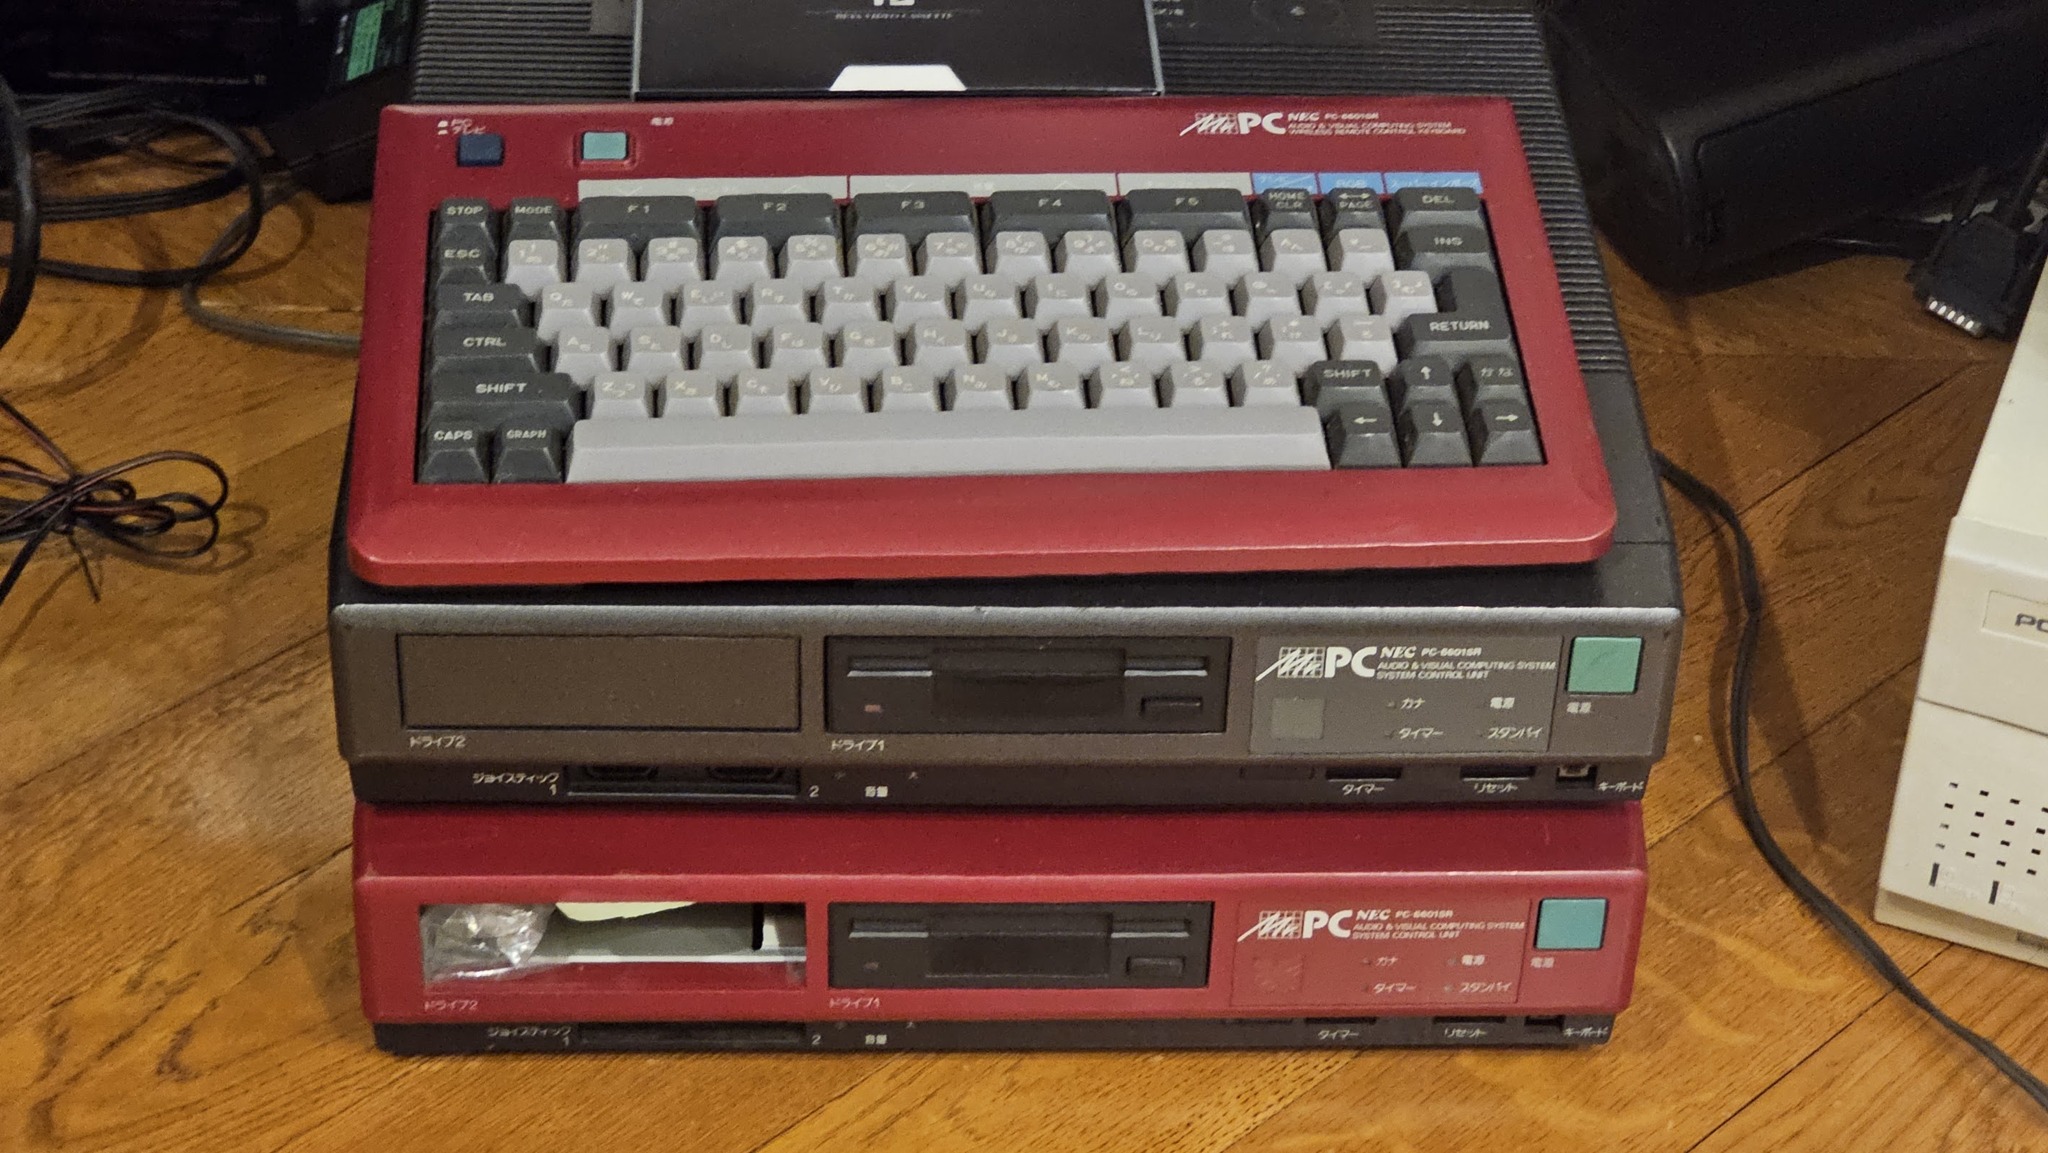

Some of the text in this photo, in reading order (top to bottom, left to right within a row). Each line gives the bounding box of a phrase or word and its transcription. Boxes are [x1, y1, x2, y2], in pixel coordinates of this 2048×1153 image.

[1288, 112, 1319, 121] NEC
[1238, 112, 1287, 134] PC
[1268, 192, 1306, 200] HOME
[1422, 195, 1456, 204] DEL
[447, 206, 484, 215] STOP
[514, 206, 552, 215] MODE
[444, 249, 480, 259] ESC
[463, 292, 495, 302] TAB
[1429, 320, 1491, 332] RETURN
[463, 337, 507, 347] CTRL
[1323, 368, 1371, 378] SHIFT
[475, 383, 527, 394] SHIFT
[434, 430, 473, 441] CAPS
[506, 429, 547, 439] GRAPH
[1380, 646, 1417, 658] NEC
[1324, 645, 1378, 679] PC
[1377, 661, 1556, 670] AUDIO & VISUAL COMPUTING SYSTEM
[1376, 670, 1489, 679] SYSTEM CONTROL UNIT
[1400, 697, 1426, 709] カナ
[1399, 727, 1443, 739] タイマー
[1487, 726, 1543, 739] スタンバイ
[809, 786, 819, 797] 2
[1342, 784, 1385, 795] タイマー
[1474, 783, 1518, 793] リセット
[1356, 909, 1391, 920] NEC
[1302, 910, 1353, 938] PC
[1353, 922, 1383, 931] AUDIO
[1395, 922, 1428, 931] VISUAL
[1430, 922, 1485, 931] COMPUTING
[1487, 922, 1525, 930] SYSTEM
[1392, 931, 1436, 939] CONTROL
[1373, 983, 1417, 994] タイマー
[811, 1034, 821, 1045] 2
[1317, 1029, 1360, 1040] タイマー
